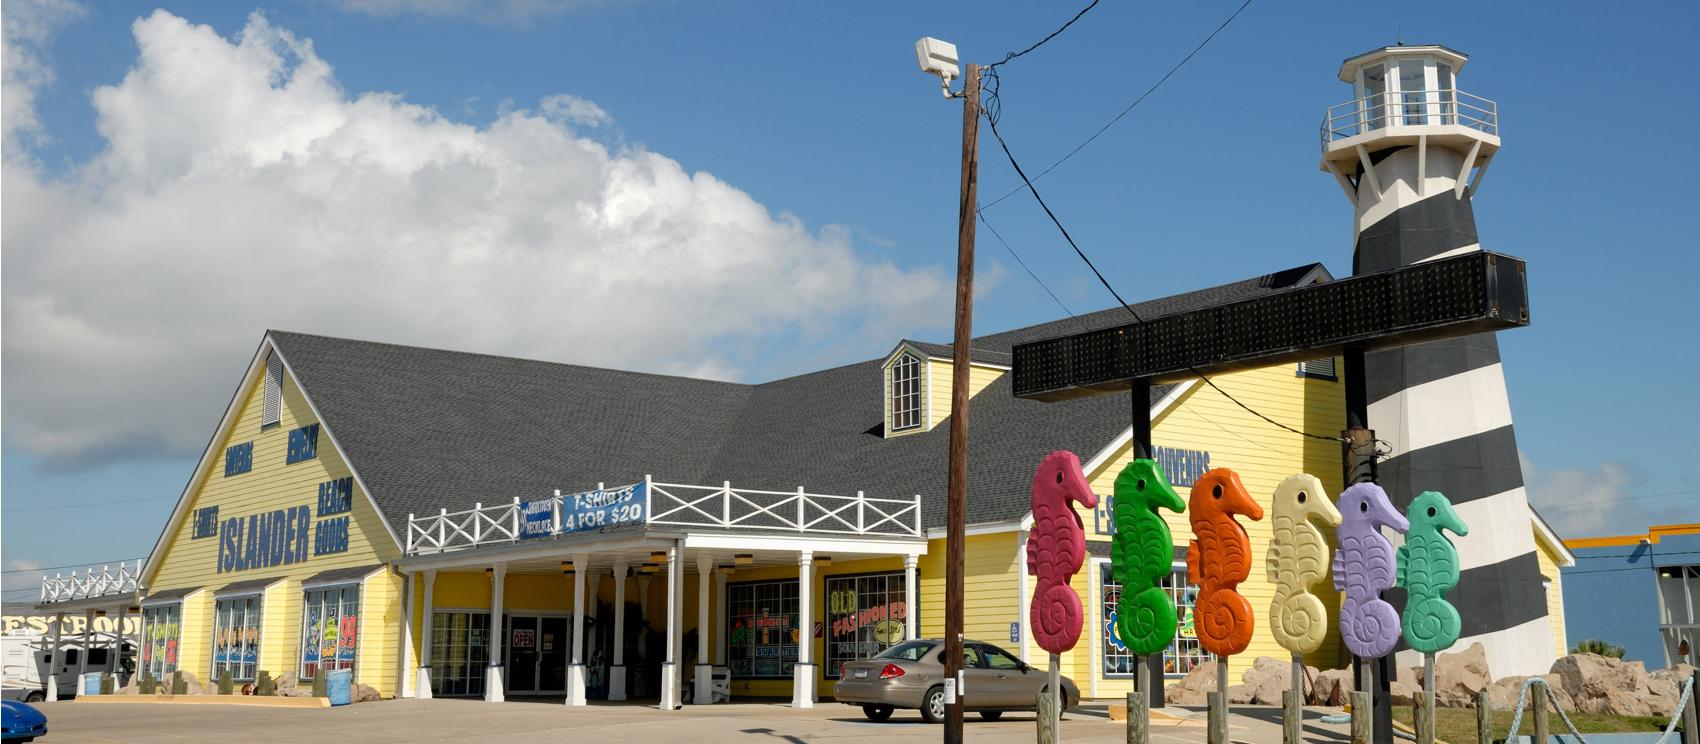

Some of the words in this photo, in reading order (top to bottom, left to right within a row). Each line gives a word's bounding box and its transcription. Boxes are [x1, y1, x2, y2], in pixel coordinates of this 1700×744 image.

[317, 475, 353, 518] BEACH
[574, 487, 634, 510] T-SHIRTS
[566, 514, 575, 529] 4
[578, 510, 606, 528] FOR
[611, 503, 642, 524] $20
[217, 504, 311, 574] ISLANDER
[314, 515, 350, 557] GOODS
[831, 590, 856, 614] OLD
[833, 602, 907, 637] FASHIONED
[514, 634, 534, 646] OPEN
